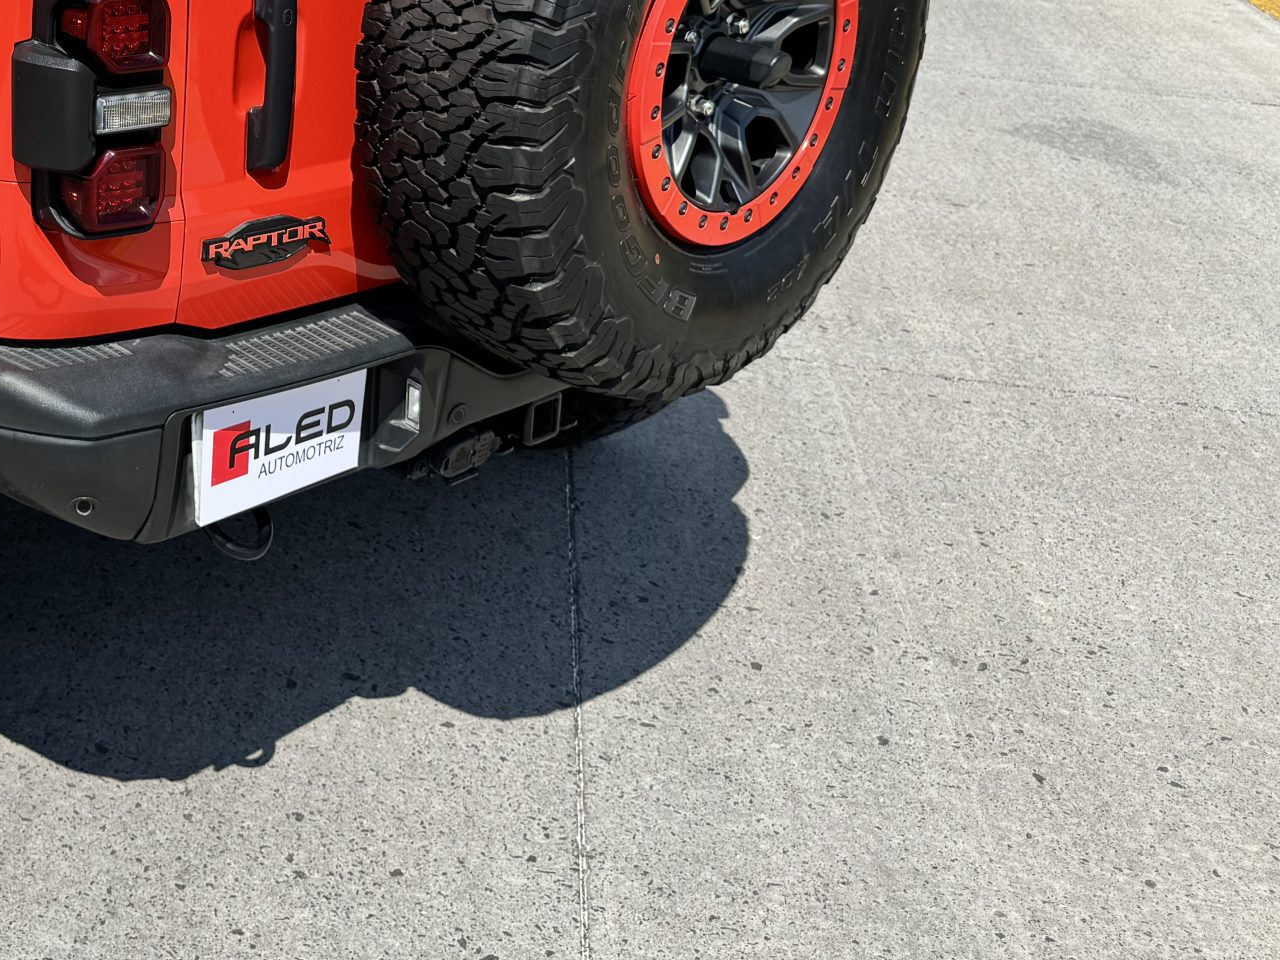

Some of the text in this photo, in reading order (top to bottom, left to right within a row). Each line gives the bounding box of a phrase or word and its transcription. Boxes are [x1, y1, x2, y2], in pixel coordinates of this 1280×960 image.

[207, 221, 327, 260] RAPTOR
[228, 399, 356, 470] ALED
[257, 434, 345, 479] AUTOMOTRIZ
